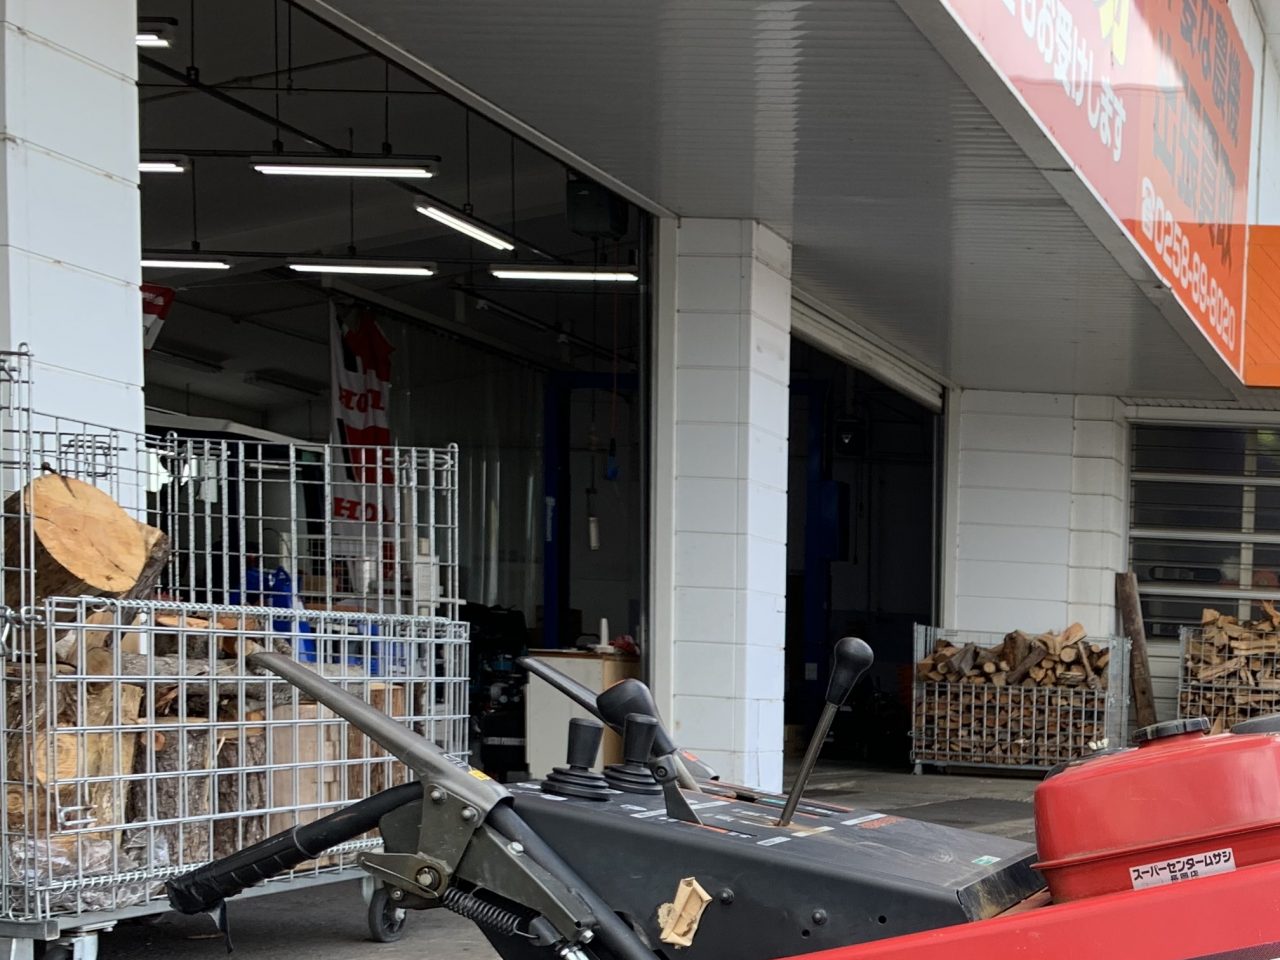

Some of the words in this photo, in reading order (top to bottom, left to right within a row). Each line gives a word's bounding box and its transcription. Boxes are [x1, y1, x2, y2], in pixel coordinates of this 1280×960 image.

[1132, 850, 1231, 881] スーパーセンタームサシ
